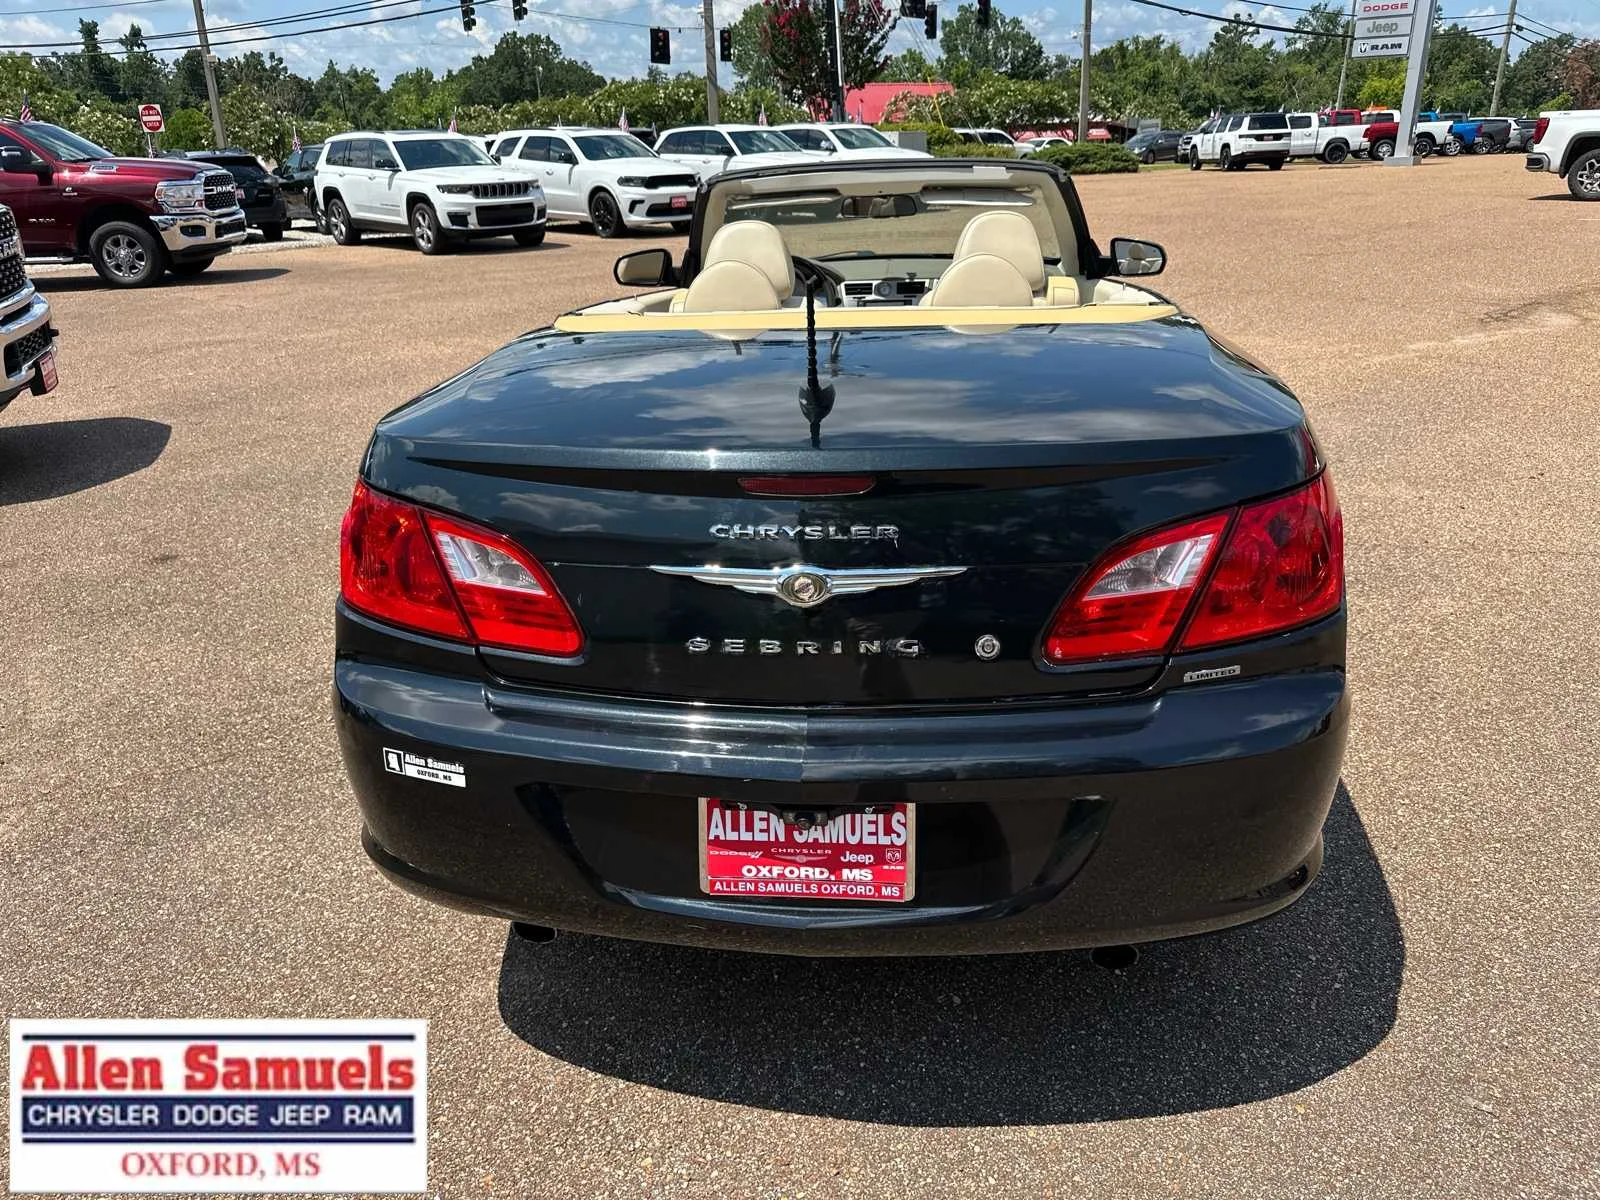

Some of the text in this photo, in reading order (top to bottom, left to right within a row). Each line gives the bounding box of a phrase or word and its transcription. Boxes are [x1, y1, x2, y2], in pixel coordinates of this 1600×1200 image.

[1363, 3, 1408, 12] DODGE
[1367, 21, 1398, 34] Jeep
[1370, 43, 1402, 51] RAM
[709, 524, 899, 540] CHRYSLER
[686, 637, 920, 657] SEBRING
[1189, 669, 1236, 680] LIMITED
[404, 753, 464, 774] Allen Samuels
[416, 768, 441, 780] OXFORD,
[708, 808, 785, 842] ALLEN
[771, 847, 832, 855] CHRYSLER
[840, 851, 874, 865] Jeep
[741, 865, 874, 881] OXFORD, MS
[714, 881, 900, 897] ALLEN SAMUELS OXFORD, MS
